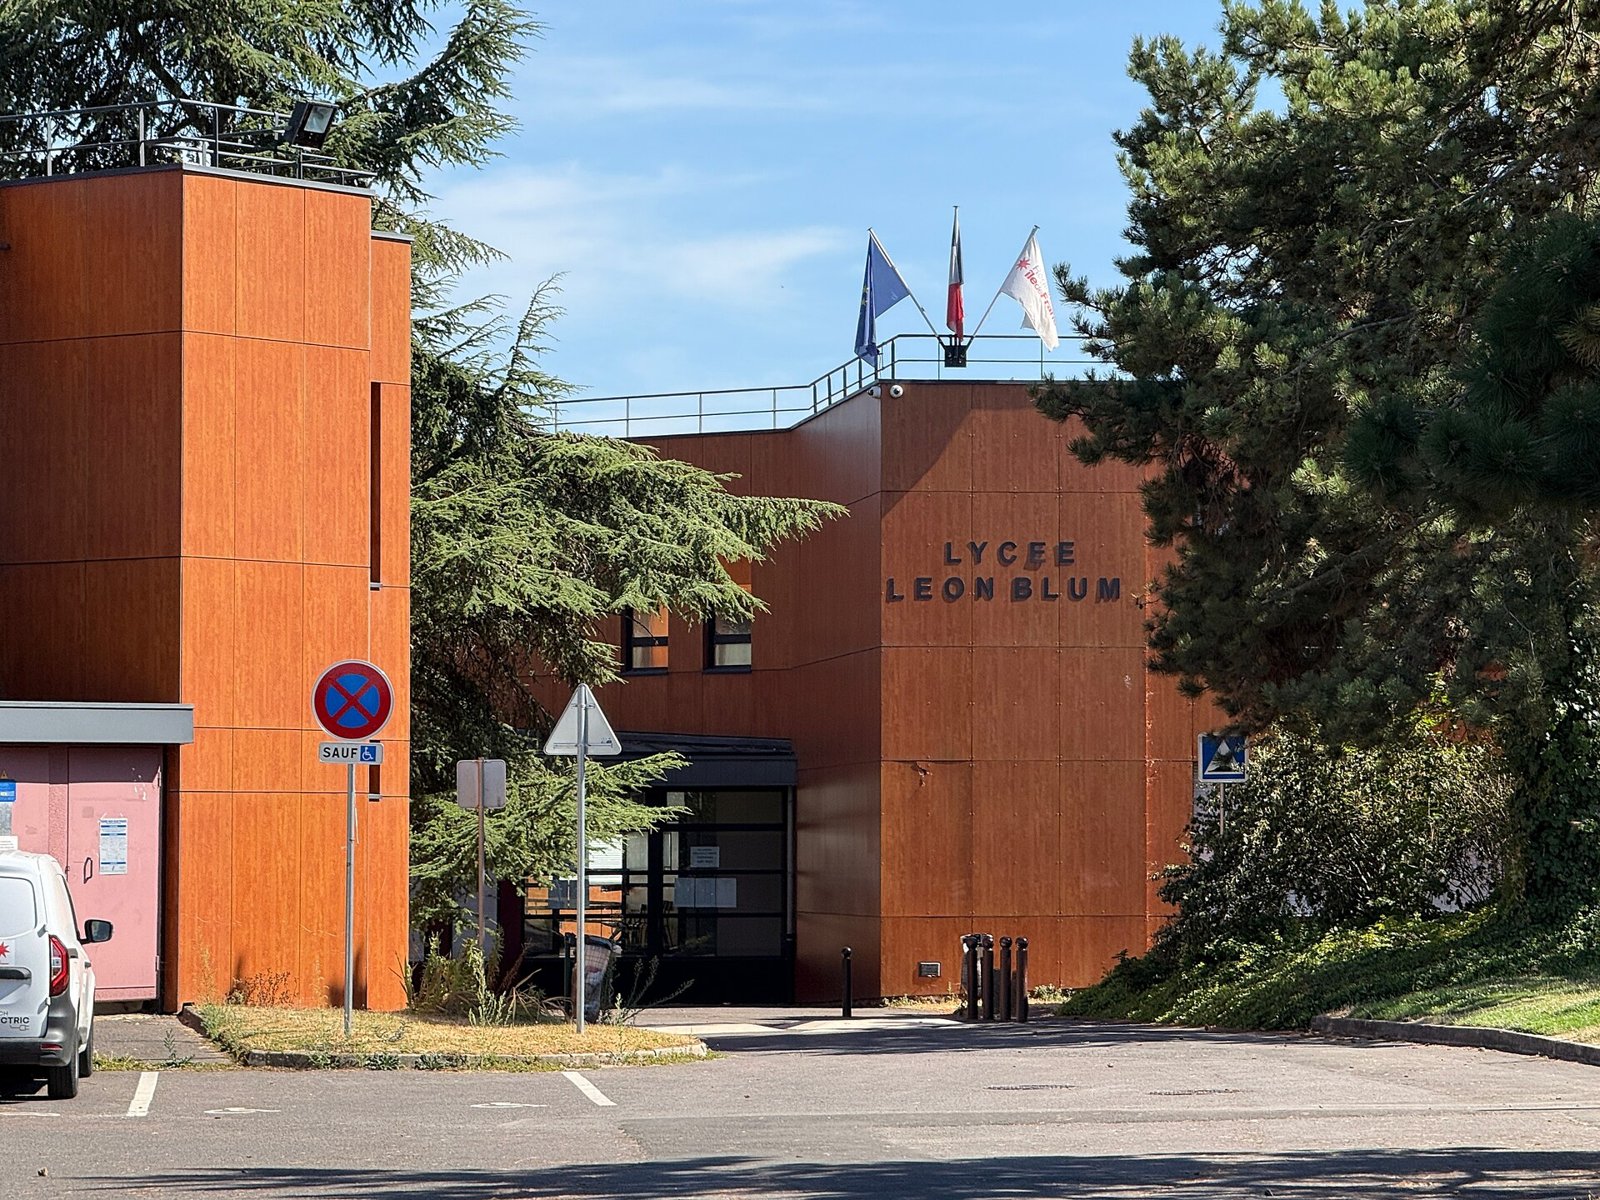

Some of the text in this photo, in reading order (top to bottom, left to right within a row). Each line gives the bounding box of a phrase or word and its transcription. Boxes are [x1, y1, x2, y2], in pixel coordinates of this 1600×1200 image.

[944, 541, 1075, 569] LYCEE
[885, 576, 1121, 603] LEON BLUM
[322, 746, 358, 758] SAUF
